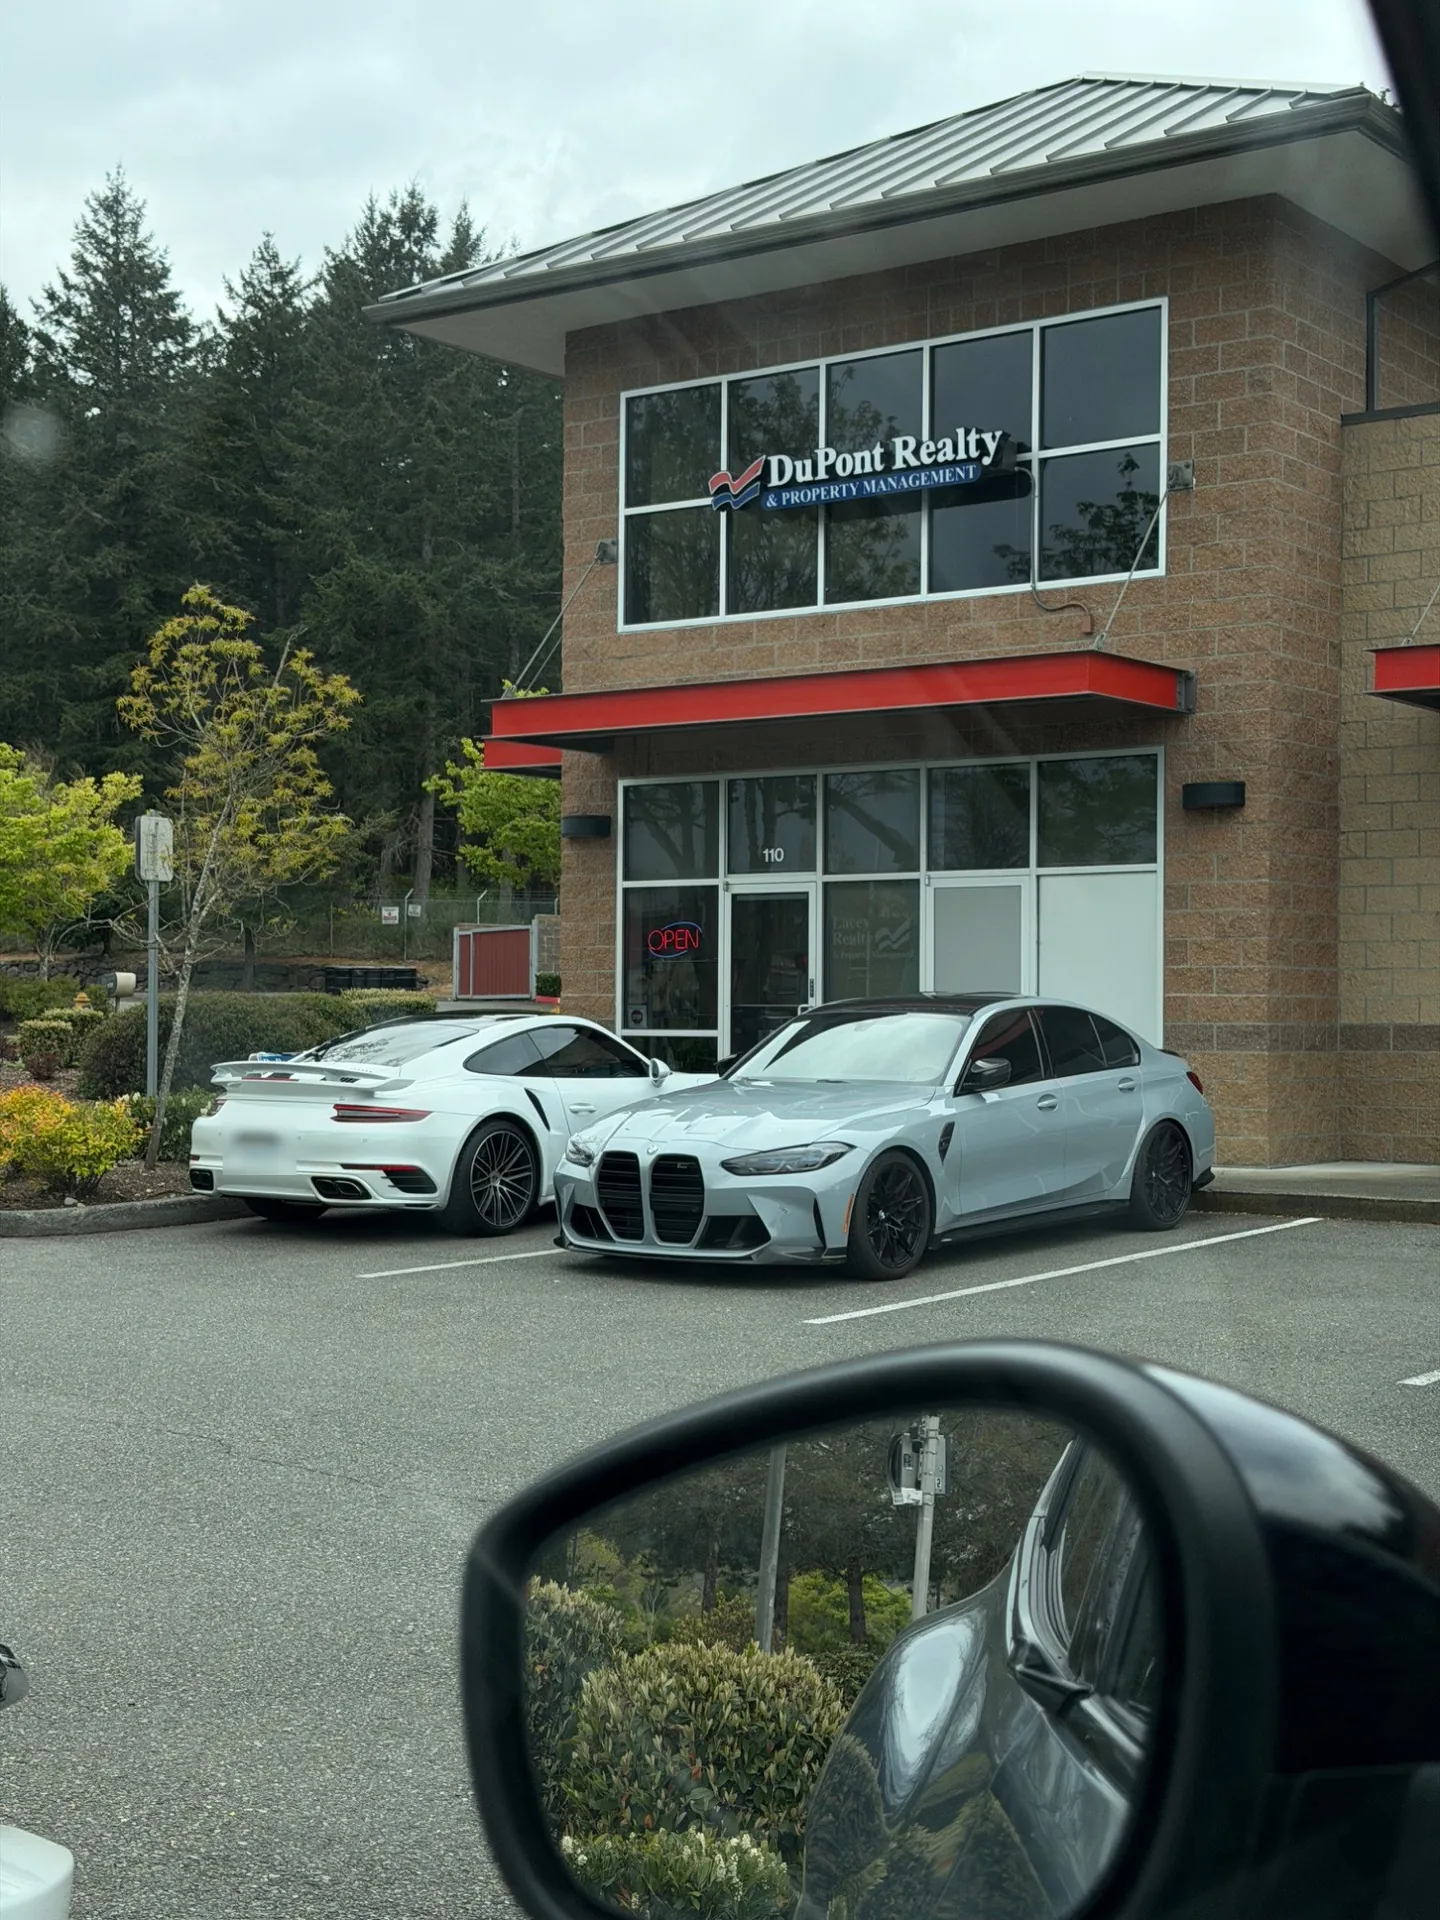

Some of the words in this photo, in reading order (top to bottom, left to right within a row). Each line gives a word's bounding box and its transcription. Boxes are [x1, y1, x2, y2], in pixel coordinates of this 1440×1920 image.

[767, 442, 885, 487] DuPont
[892, 427, 1003, 470] Realty
[766, 494, 778, 508] &
[782, 480, 859, 506] PROPERTY
[862, 464, 977, 495] MANAGEMENT
[762, 847, 785, 863] 110
[648, 929, 699, 951] OPEN
